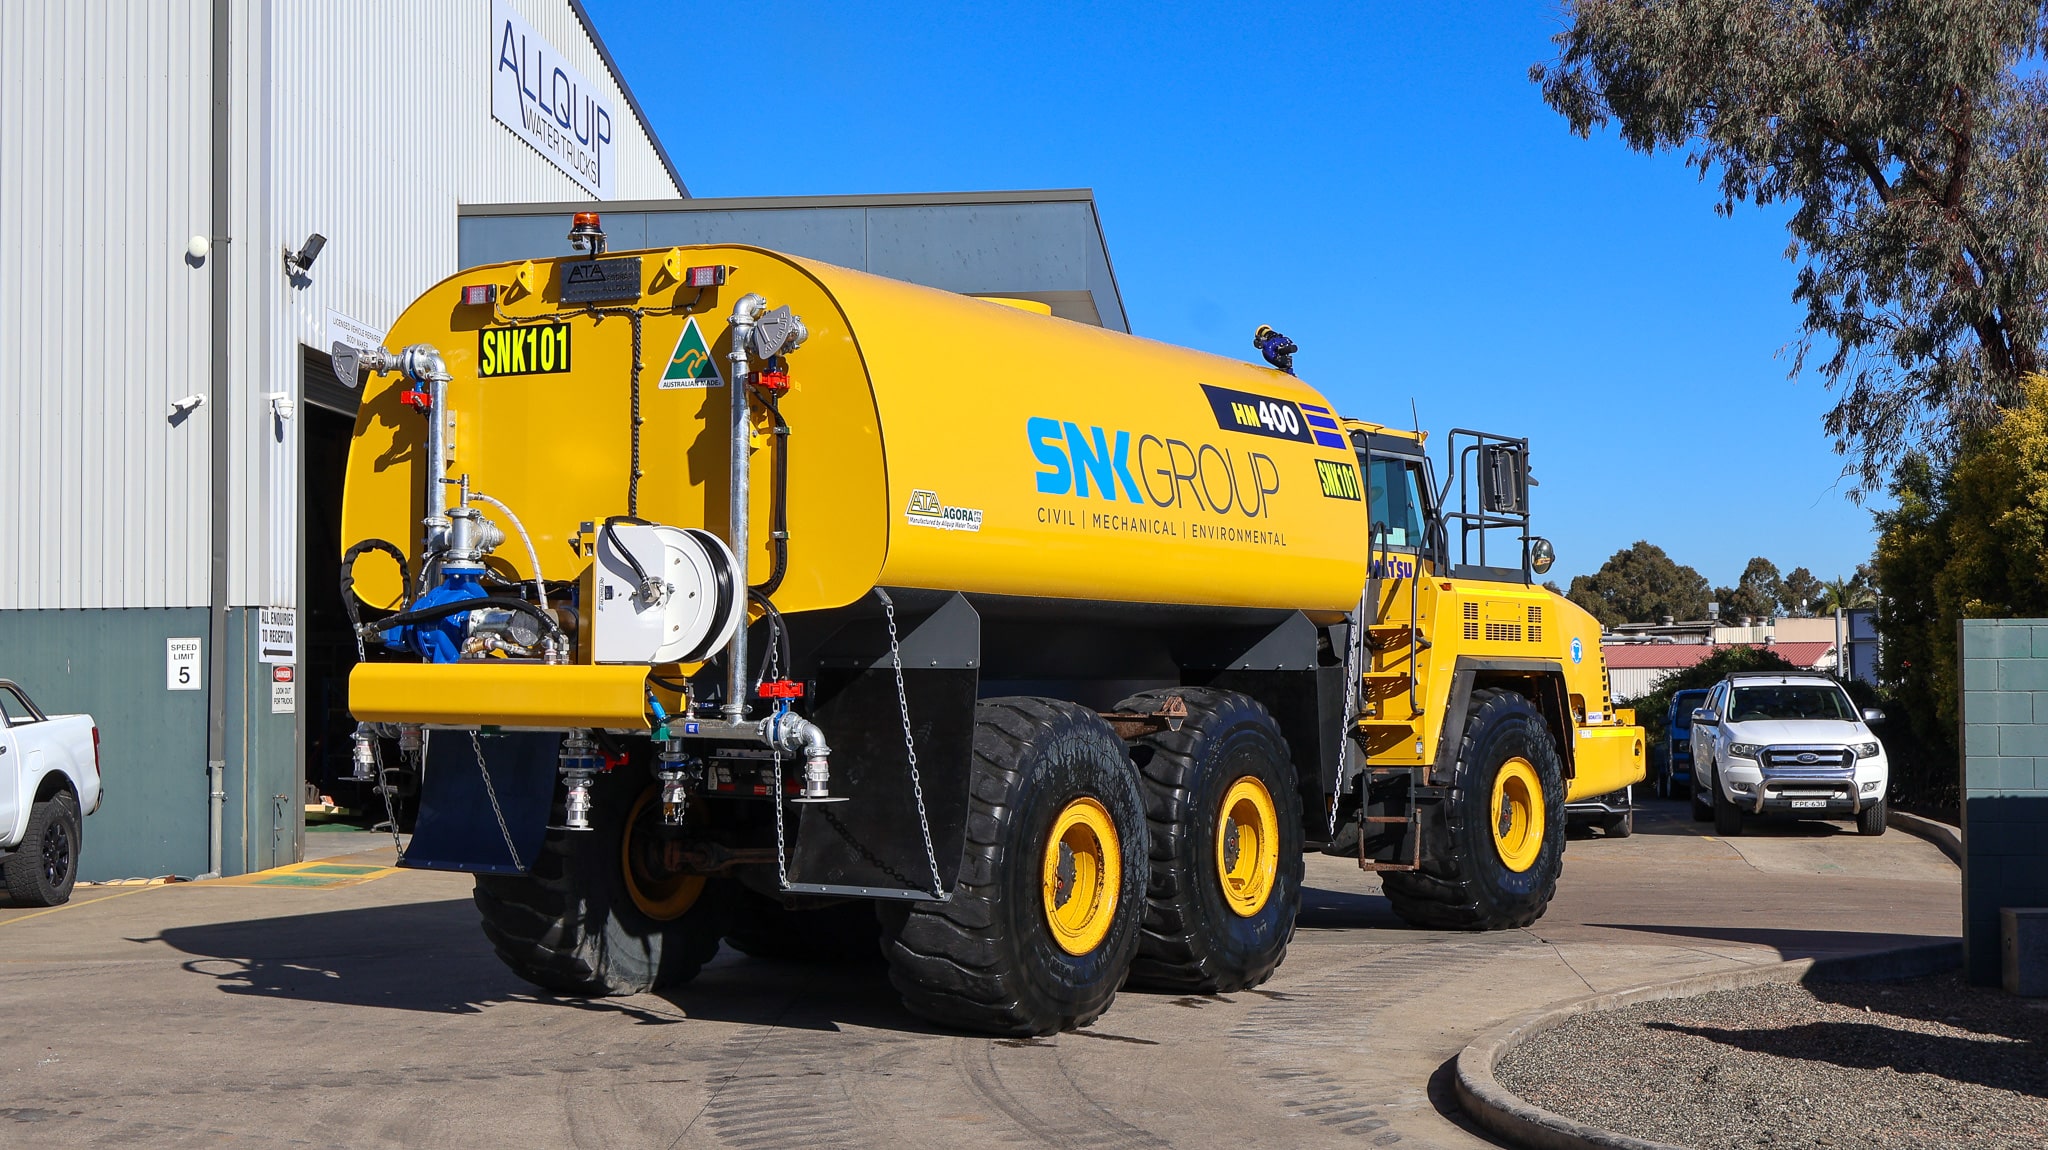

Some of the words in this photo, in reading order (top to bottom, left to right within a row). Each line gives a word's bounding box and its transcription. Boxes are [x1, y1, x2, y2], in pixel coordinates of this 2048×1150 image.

[498, 19, 611, 188] ALLQUIP
[525, 104, 560, 156] WATER
[560, 134, 597, 185] TRUCKS
[482, 325, 567, 375] SNK101
[662, 380, 699, 388] AUSTRALIAN
[700, 379, 720, 387] MADE
[1316, 460, 1361, 500] SNK101
[906, 490, 943, 519] ATA
[943, 507, 974, 522] AGORA
[909, 516, 936, 526] Manufactured
[955, 521, 967, 529] Water
[966, 522, 979, 530] Trucks
[1037, 507, 1075, 526] CIVIL
[1092, 513, 1177, 536] MECHANICAL
[1191, 523, 1287, 547] ENVIRONMENTAL
[261, 611, 269, 624] ALL
[271, 611, 294, 626] ENQUIRIES
[262, 629, 268, 642] TO
[269, 629, 293, 644] RECEPTION
[179, 666, 190, 684] 5
[275, 687, 284, 695] LOOK
